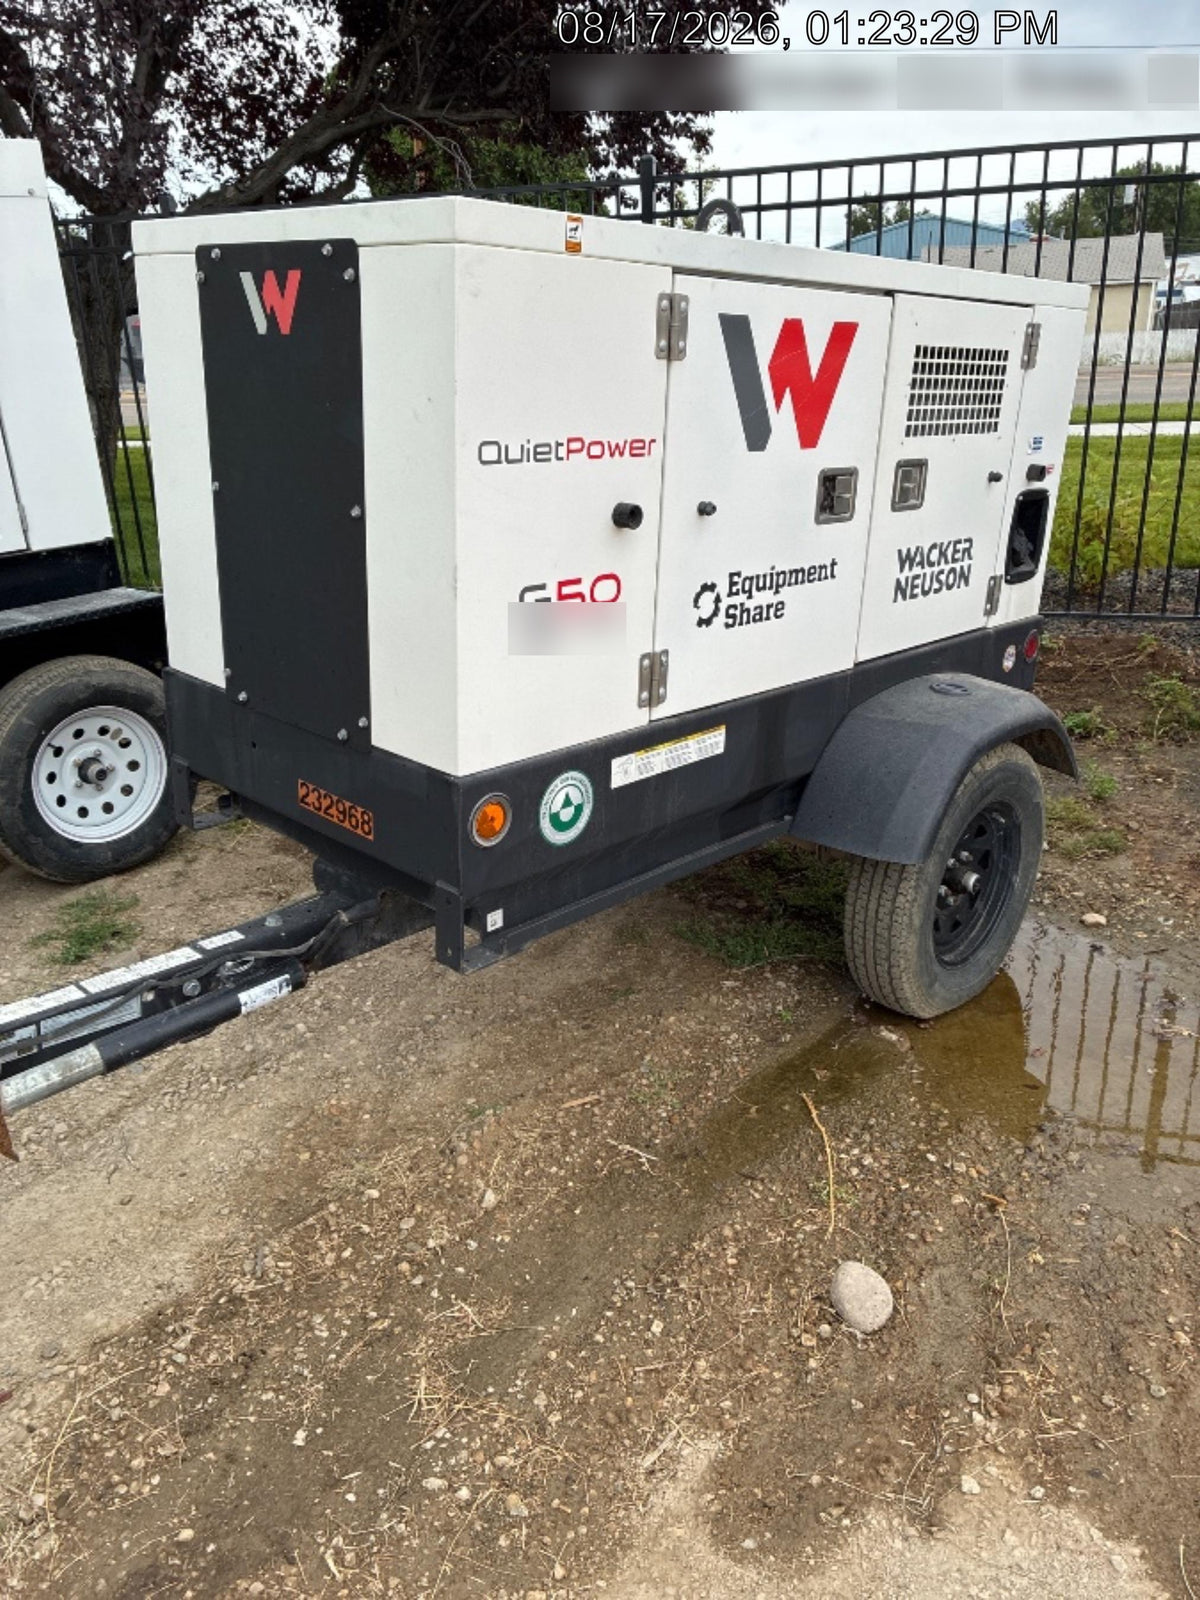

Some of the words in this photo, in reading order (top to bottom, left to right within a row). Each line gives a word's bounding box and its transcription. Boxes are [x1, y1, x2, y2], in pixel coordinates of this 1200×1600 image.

[478, 437, 657, 465] QuietPower
[897, 538, 973, 573] WACKER
[727, 557, 838, 599] Equipment
[893, 565, 972, 603] NEUSON
[724, 600, 786, 629] Share
[299, 781, 373, 836] 232968
